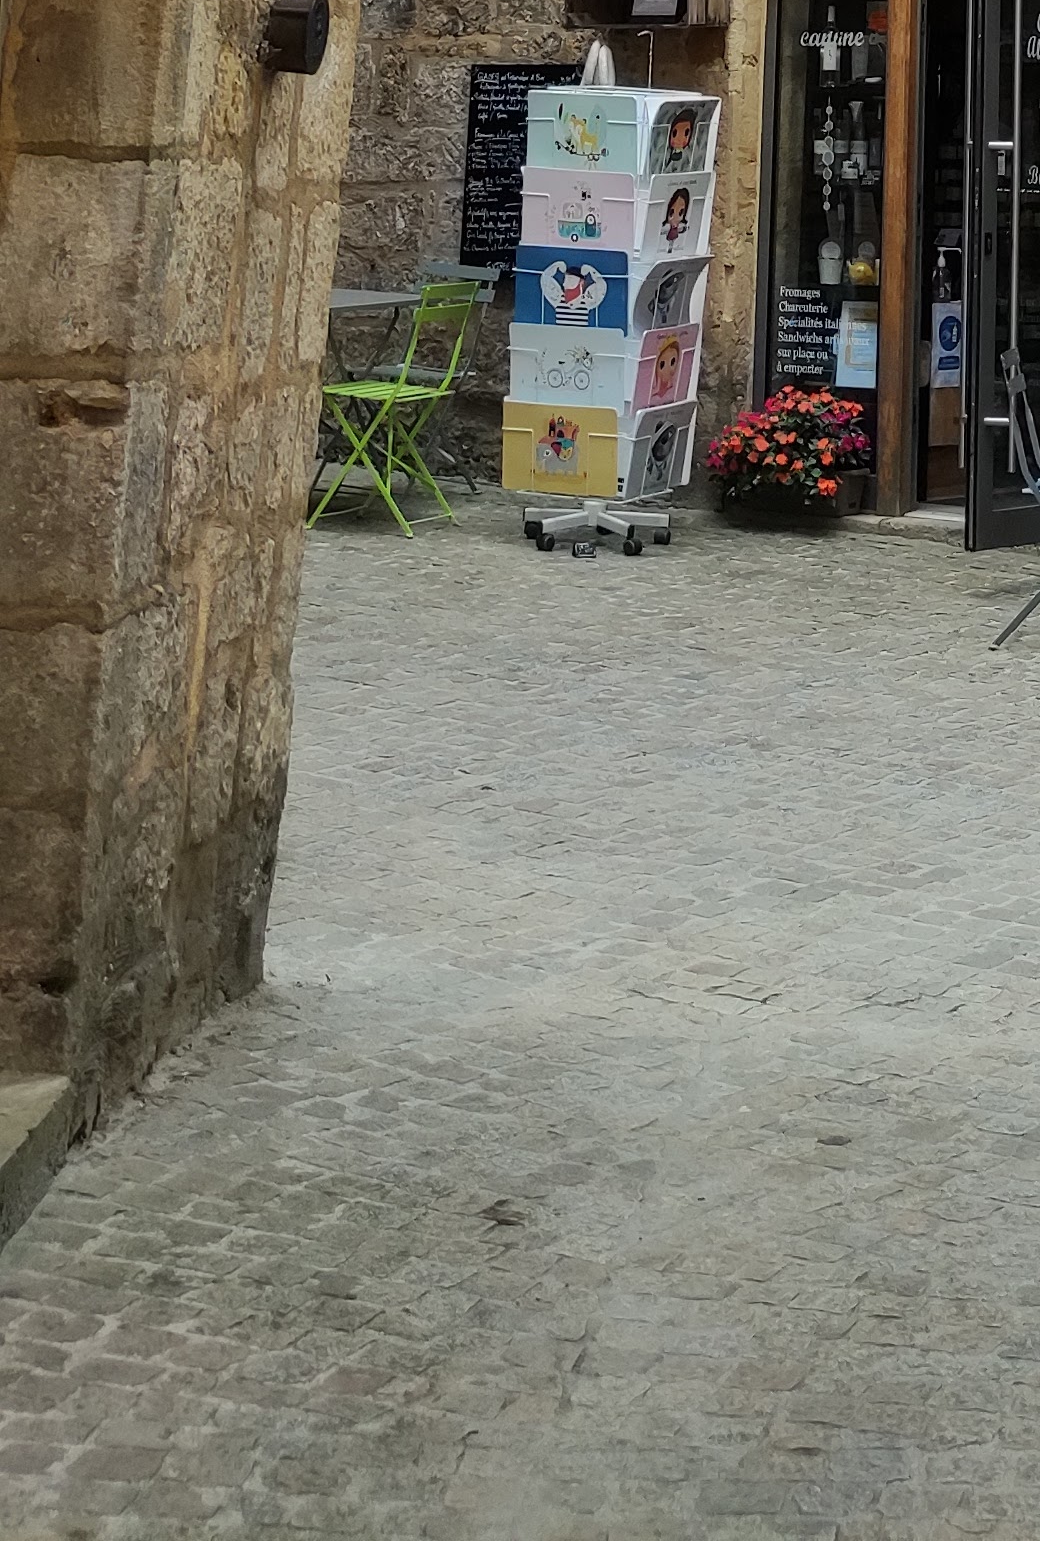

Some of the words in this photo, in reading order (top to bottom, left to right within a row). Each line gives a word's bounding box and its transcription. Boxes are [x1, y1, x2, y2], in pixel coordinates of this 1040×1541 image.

[780, 285, 821, 300] Fromages
[778, 300, 829, 314] Charcuterie
[778, 315, 823, 330] Spécialités
[777, 330, 823, 345] Sandwichs
[776, 347, 791, 358] sur
[793, 347, 816, 360] place
[816, 350, 829, 360] ou
[776, 360, 783, 373] à
[784, 363, 824, 376] emporter
